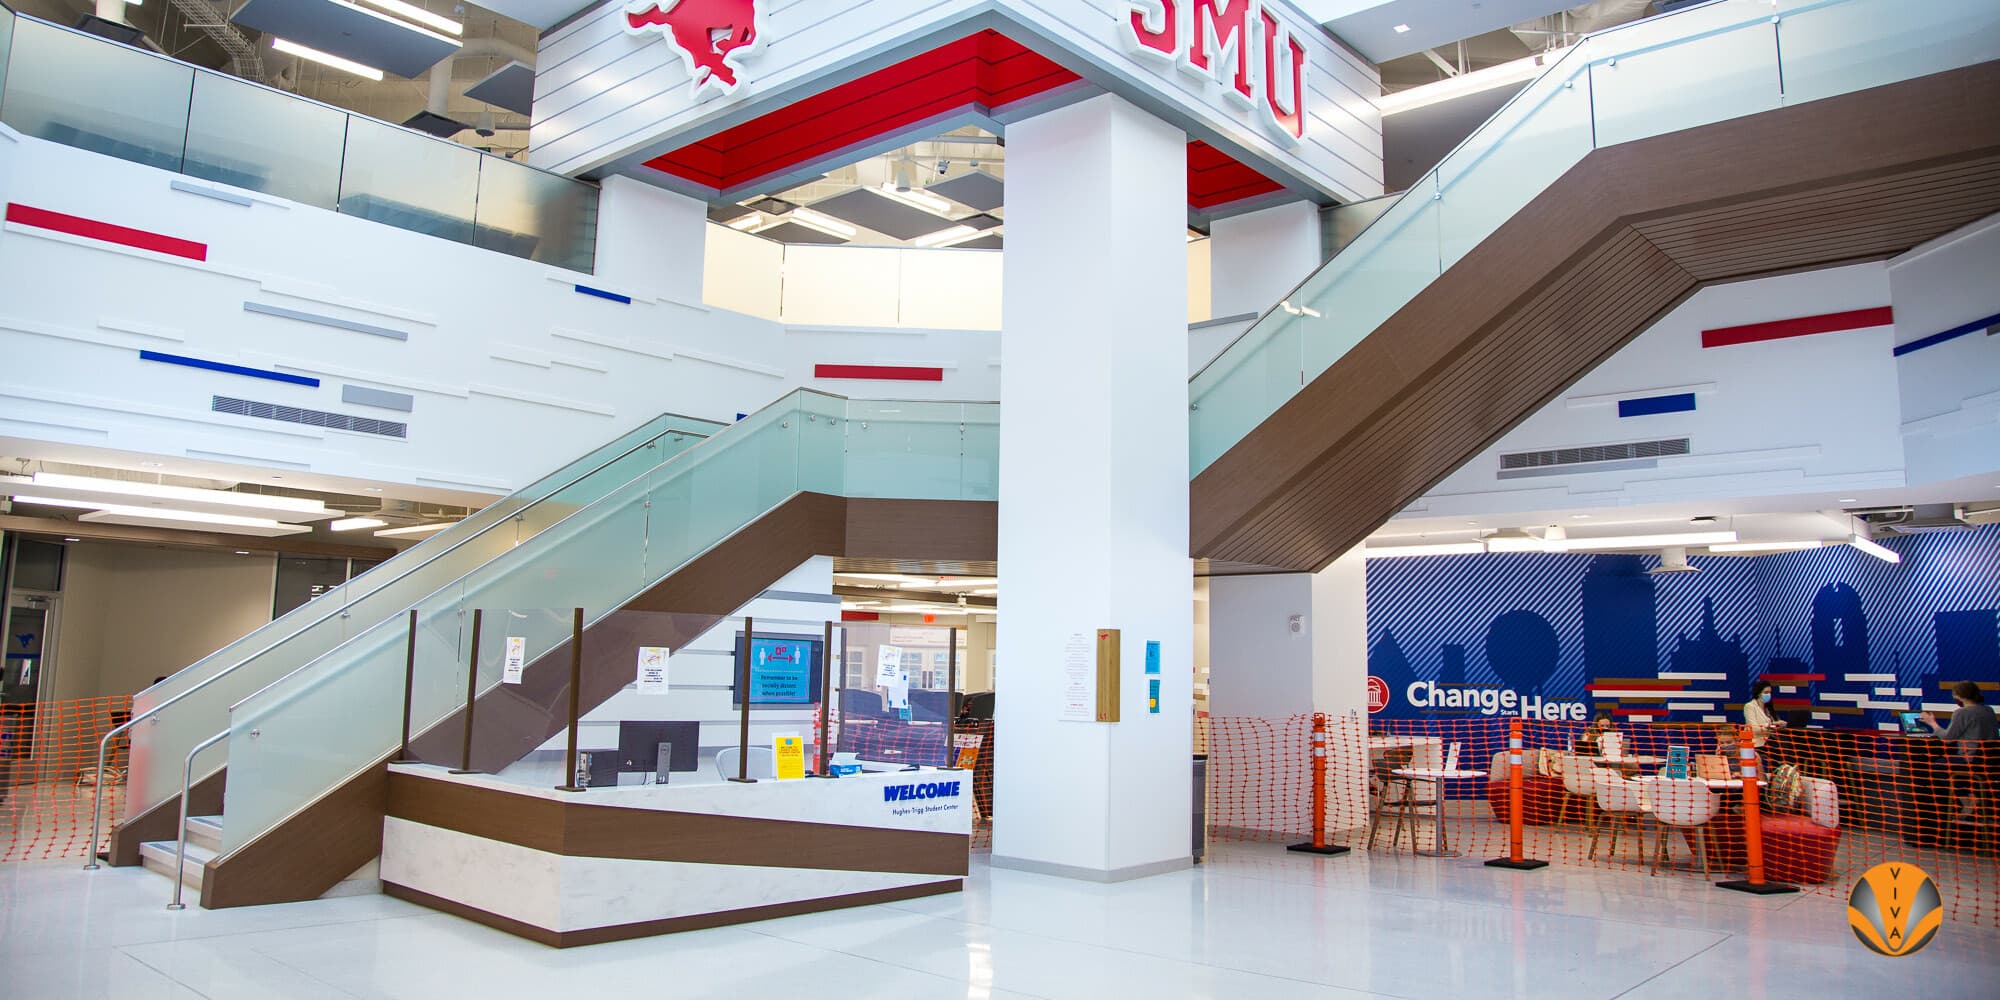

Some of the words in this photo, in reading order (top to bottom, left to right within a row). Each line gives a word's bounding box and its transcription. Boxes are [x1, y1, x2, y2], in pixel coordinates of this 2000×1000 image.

[1125, 0, 1306, 141] SMU
[1406, 680, 1517, 716] Change
[1520, 695, 1587, 721] Here
[883, 781, 961, 801] WELCOME
[892, 807, 924, 816] Hughes-Trigg
